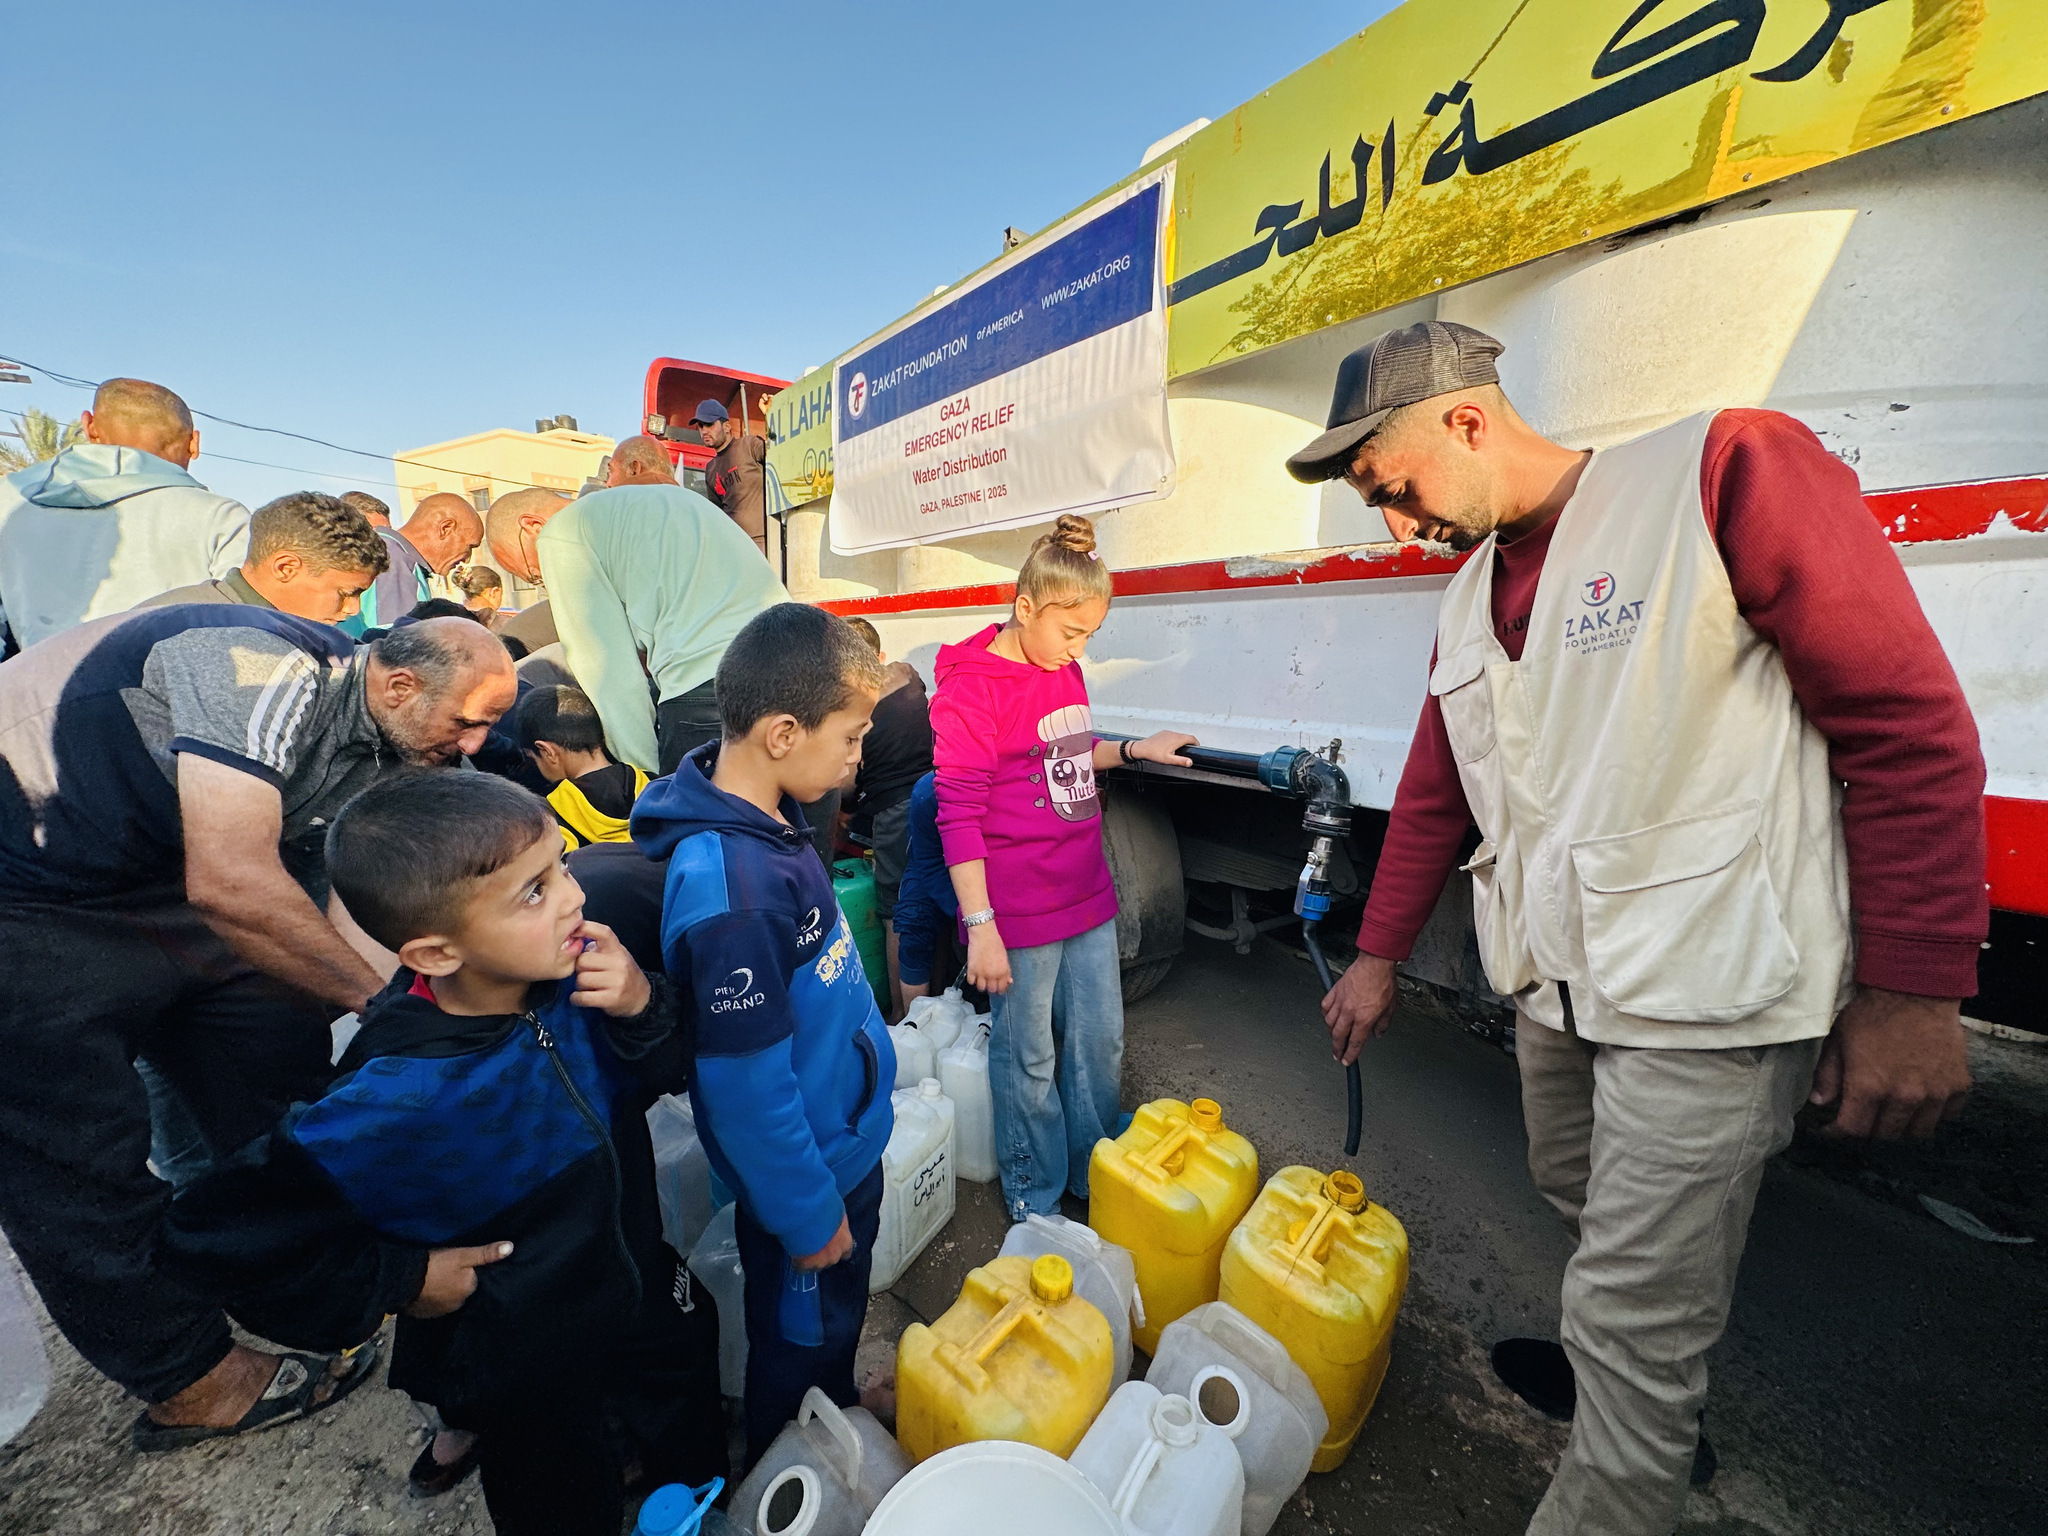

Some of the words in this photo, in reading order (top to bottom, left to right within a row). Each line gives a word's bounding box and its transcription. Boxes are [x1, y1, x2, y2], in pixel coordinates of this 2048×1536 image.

[1166, 117, 1394, 306] اللح
[871, 367, 902, 397] ZAKAT
[903, 335, 967, 380] FOUNDATION
[986, 309, 1024, 337] AMERICA
[1041, 255, 1130, 310] WWW.ZAKAT.ORG
[769, 409, 785, 446] AL
[790, 381, 832, 438] LAHA
[940, 397, 970, 421] GAZA
[905, 421, 969, 457] EMERGENCY
[971, 404, 1015, 435] RELIEF
[912, 466, 941, 486] Water
[943, 447, 1007, 477] Distribution
[920, 501, 941, 515] GAZA,
[942, 490, 981, 509] PALESTINE
[988, 484, 1008, 500] 2025
[1565, 600, 1643, 638] ZAKAT
[1565, 626, 1637, 650] FOUNDATIO
[1581, 646, 1590, 655] of
[1592, 639, 1632, 653] AMERICA
[711, 992, 765, 1014] GRAND
